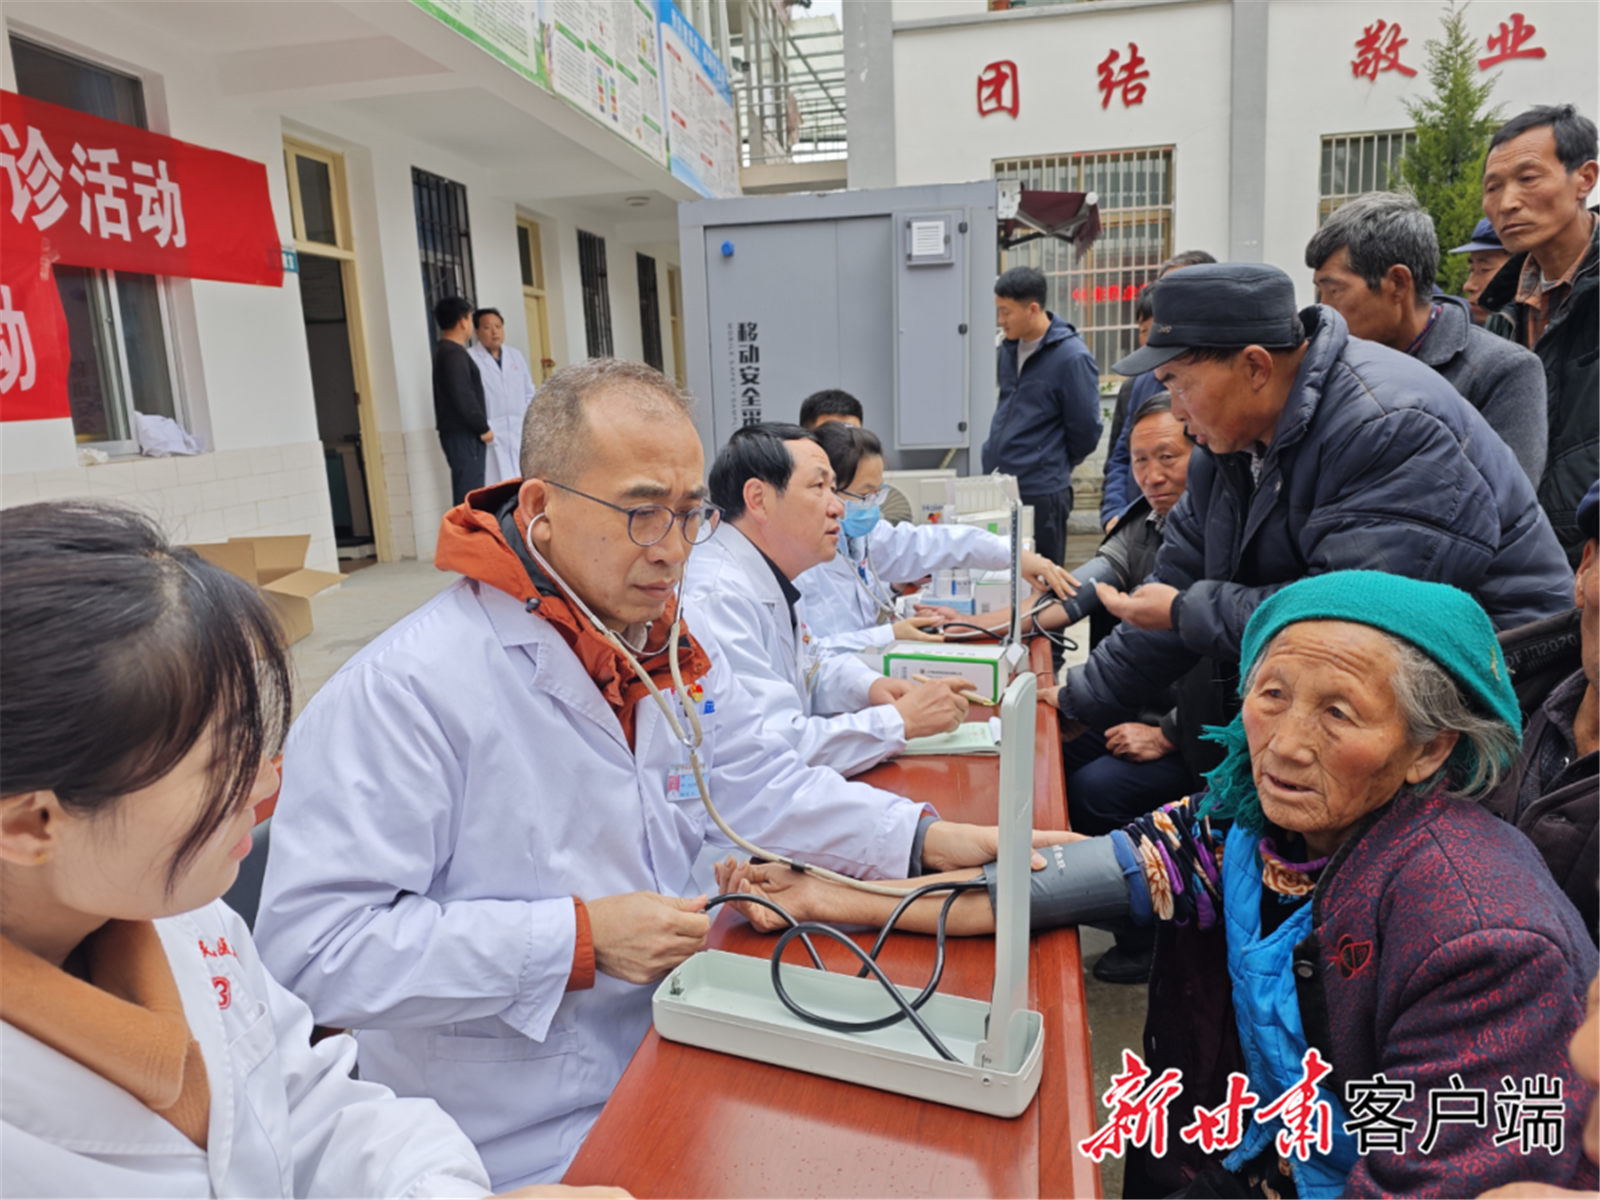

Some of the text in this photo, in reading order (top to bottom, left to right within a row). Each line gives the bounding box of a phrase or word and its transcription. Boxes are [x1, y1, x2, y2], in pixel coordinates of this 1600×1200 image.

[977, 13, 1547, 119] 团结 敬业
[0, 122, 187, 248] 诊活动
